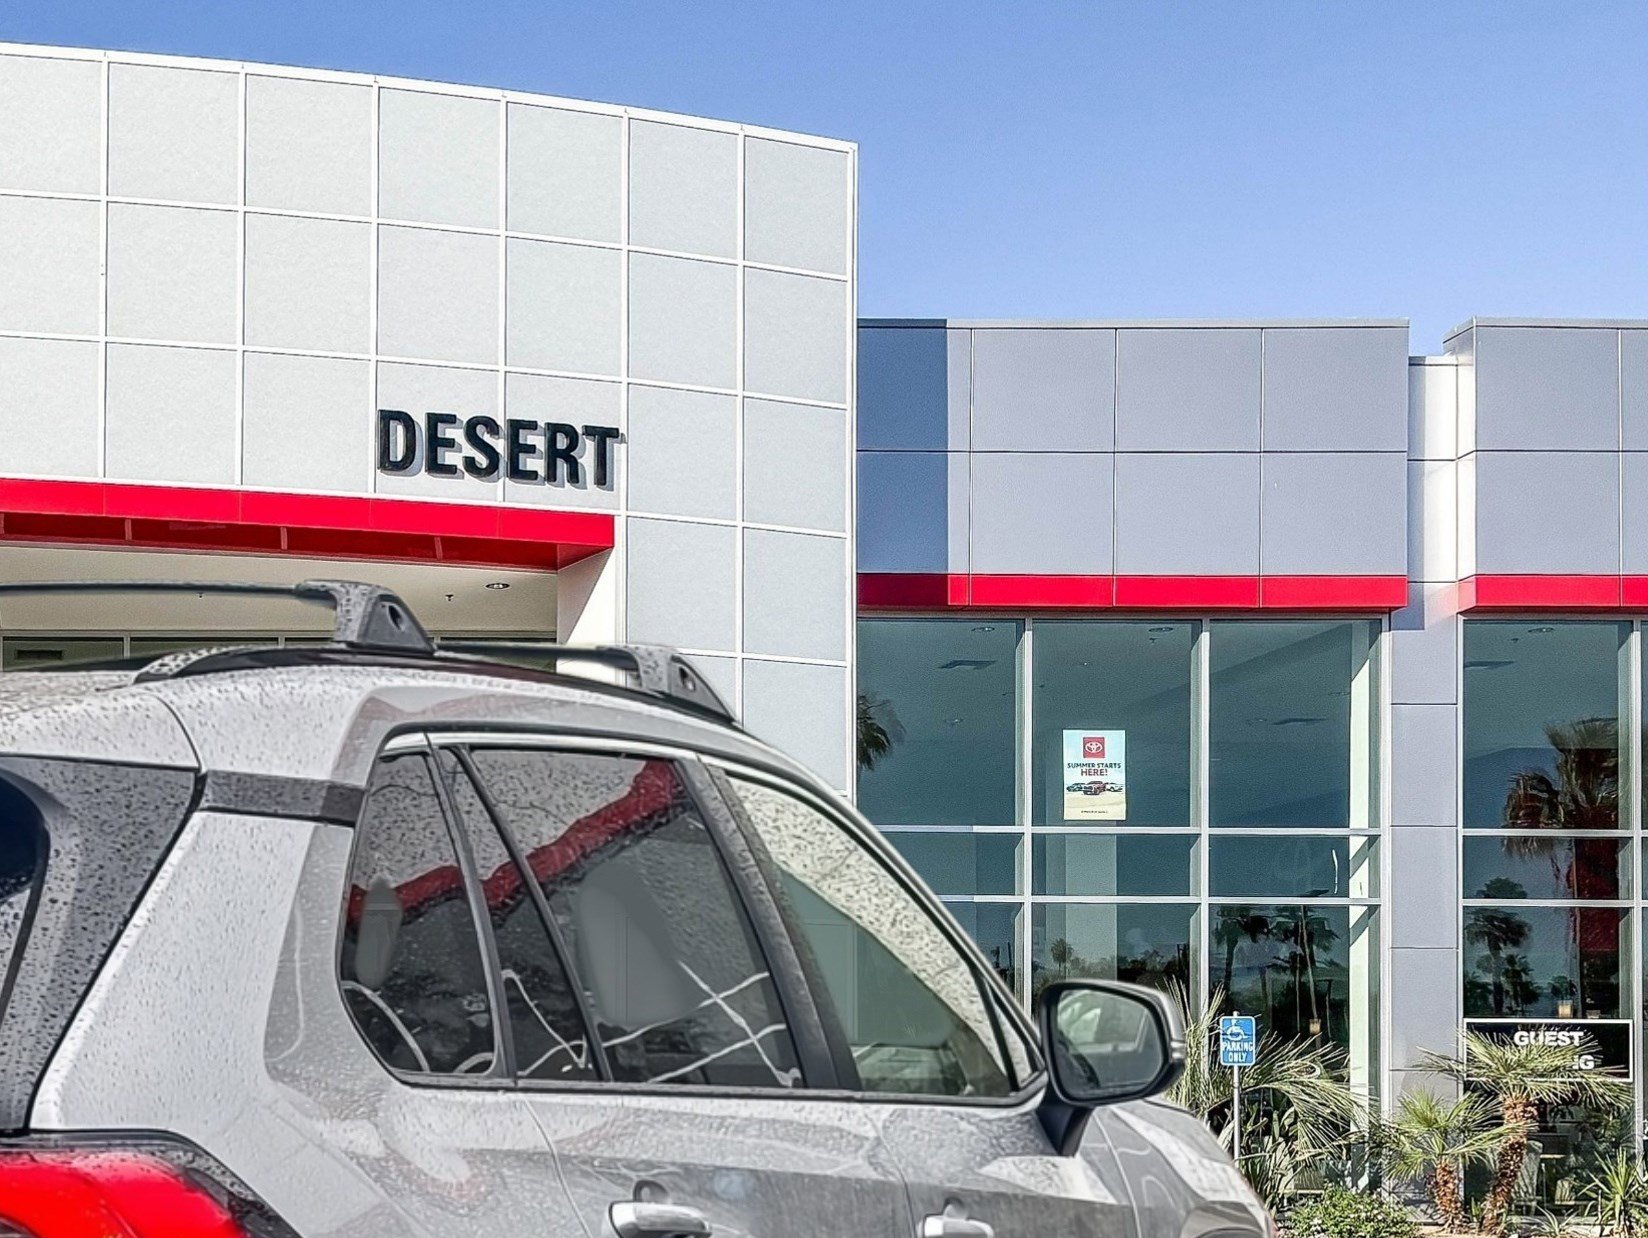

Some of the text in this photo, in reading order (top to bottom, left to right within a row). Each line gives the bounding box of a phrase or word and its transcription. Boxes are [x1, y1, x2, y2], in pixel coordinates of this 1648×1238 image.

[376, 409, 621, 487] DESERT
[1080, 768, 1108, 776] HERE!
[1513, 1030, 1585, 1047] GUEST
[1221, 1041, 1254, 1052] PARKING
[1228, 1051, 1248, 1063] ONLY
